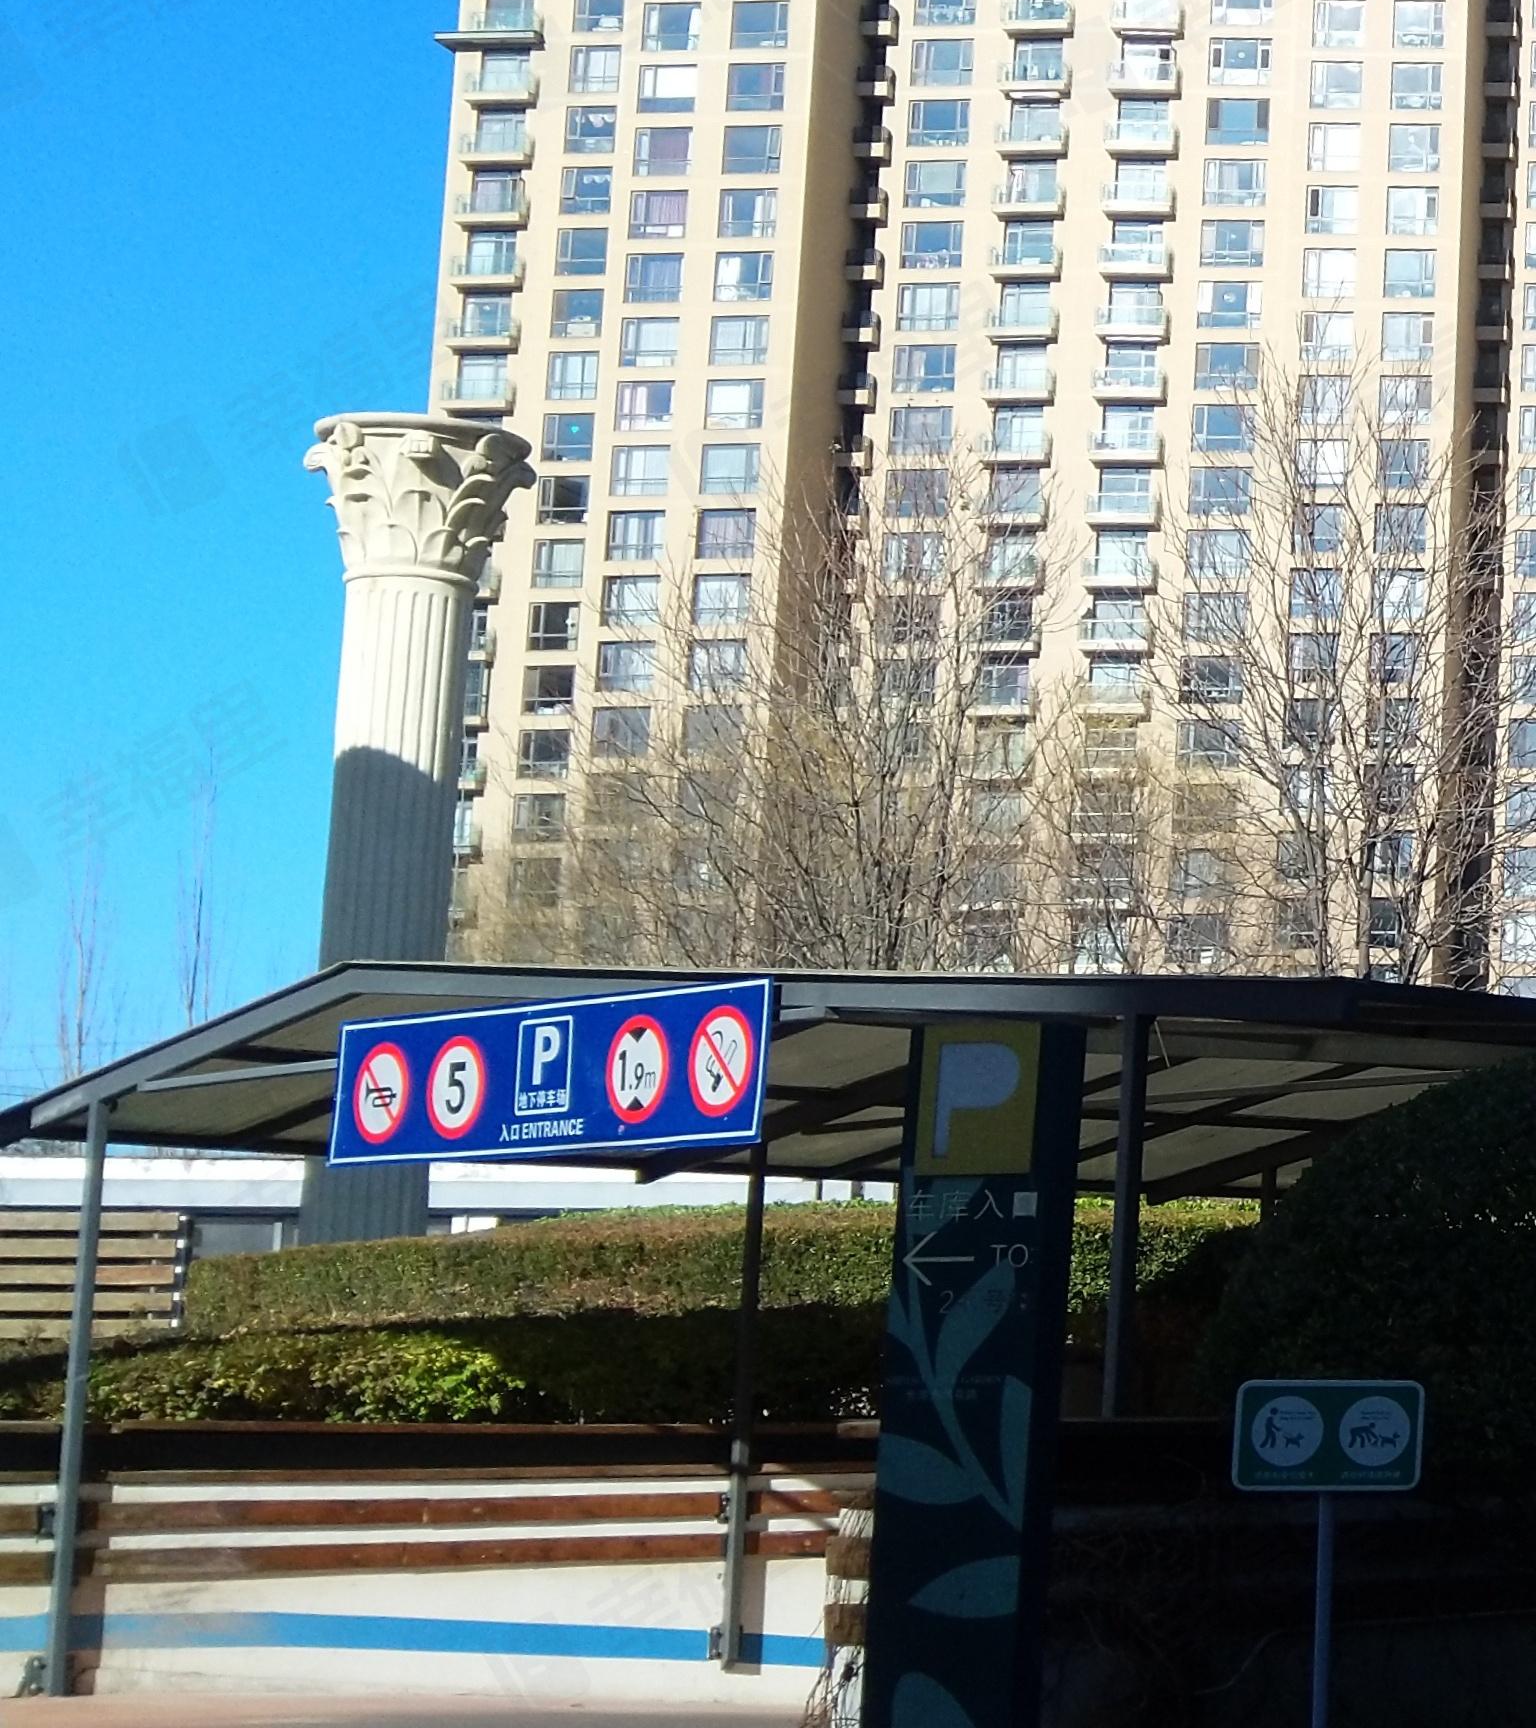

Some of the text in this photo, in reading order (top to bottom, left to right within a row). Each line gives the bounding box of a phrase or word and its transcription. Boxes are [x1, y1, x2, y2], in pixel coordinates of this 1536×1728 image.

[531, 1024, 561, 1086] P
[618, 1049, 657, 1092] 1.9m
[445, 1061, 466, 1115] 5
[933, 1042, 1021, 1155] P
[499, 1118, 585, 1142] 入口 ENTRANCE
[908, 1188, 1038, 1224] 车库入口
